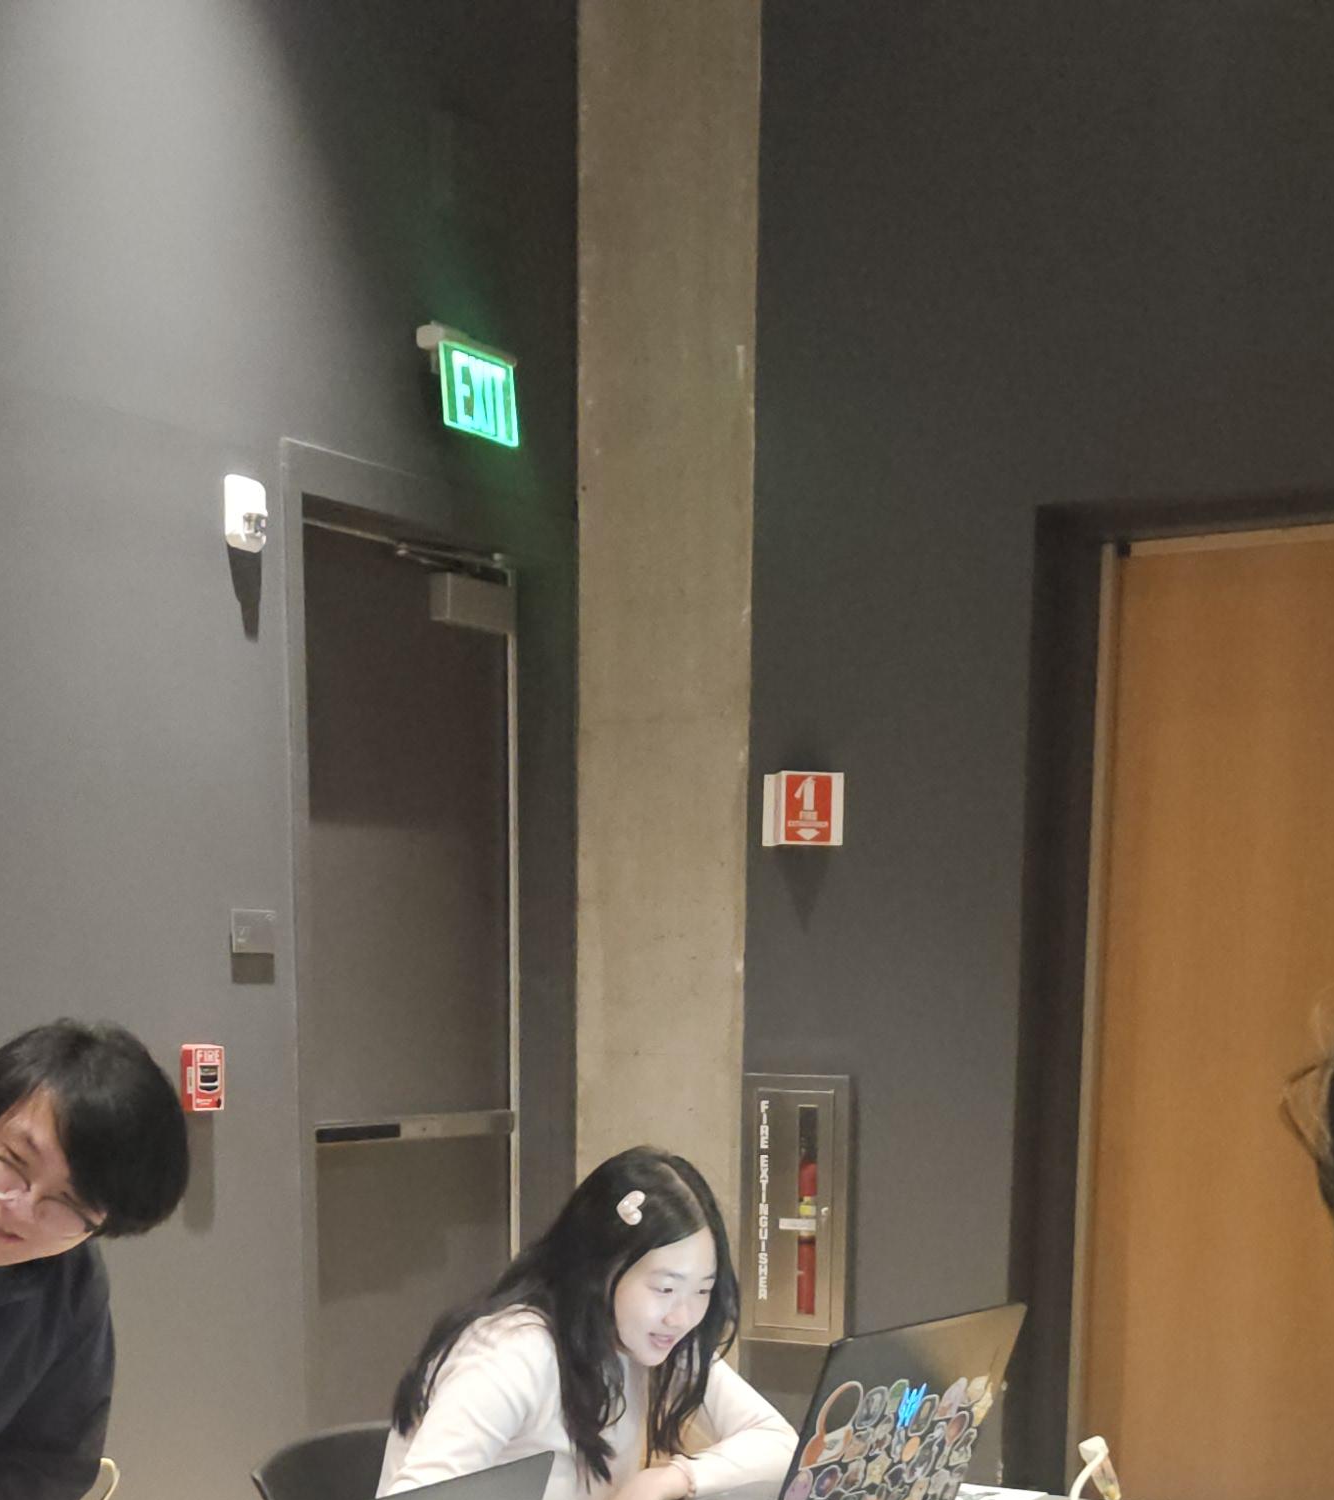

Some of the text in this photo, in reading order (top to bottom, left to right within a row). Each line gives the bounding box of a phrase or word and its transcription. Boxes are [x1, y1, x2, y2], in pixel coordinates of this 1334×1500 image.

[452, 350, 507, 440] EXIT
[799, 811, 818, 820] FIRE
[197, 1050, 220, 1062] FIRE
[758, 1101, 770, 1300] FIRE EXTINGUISHER
